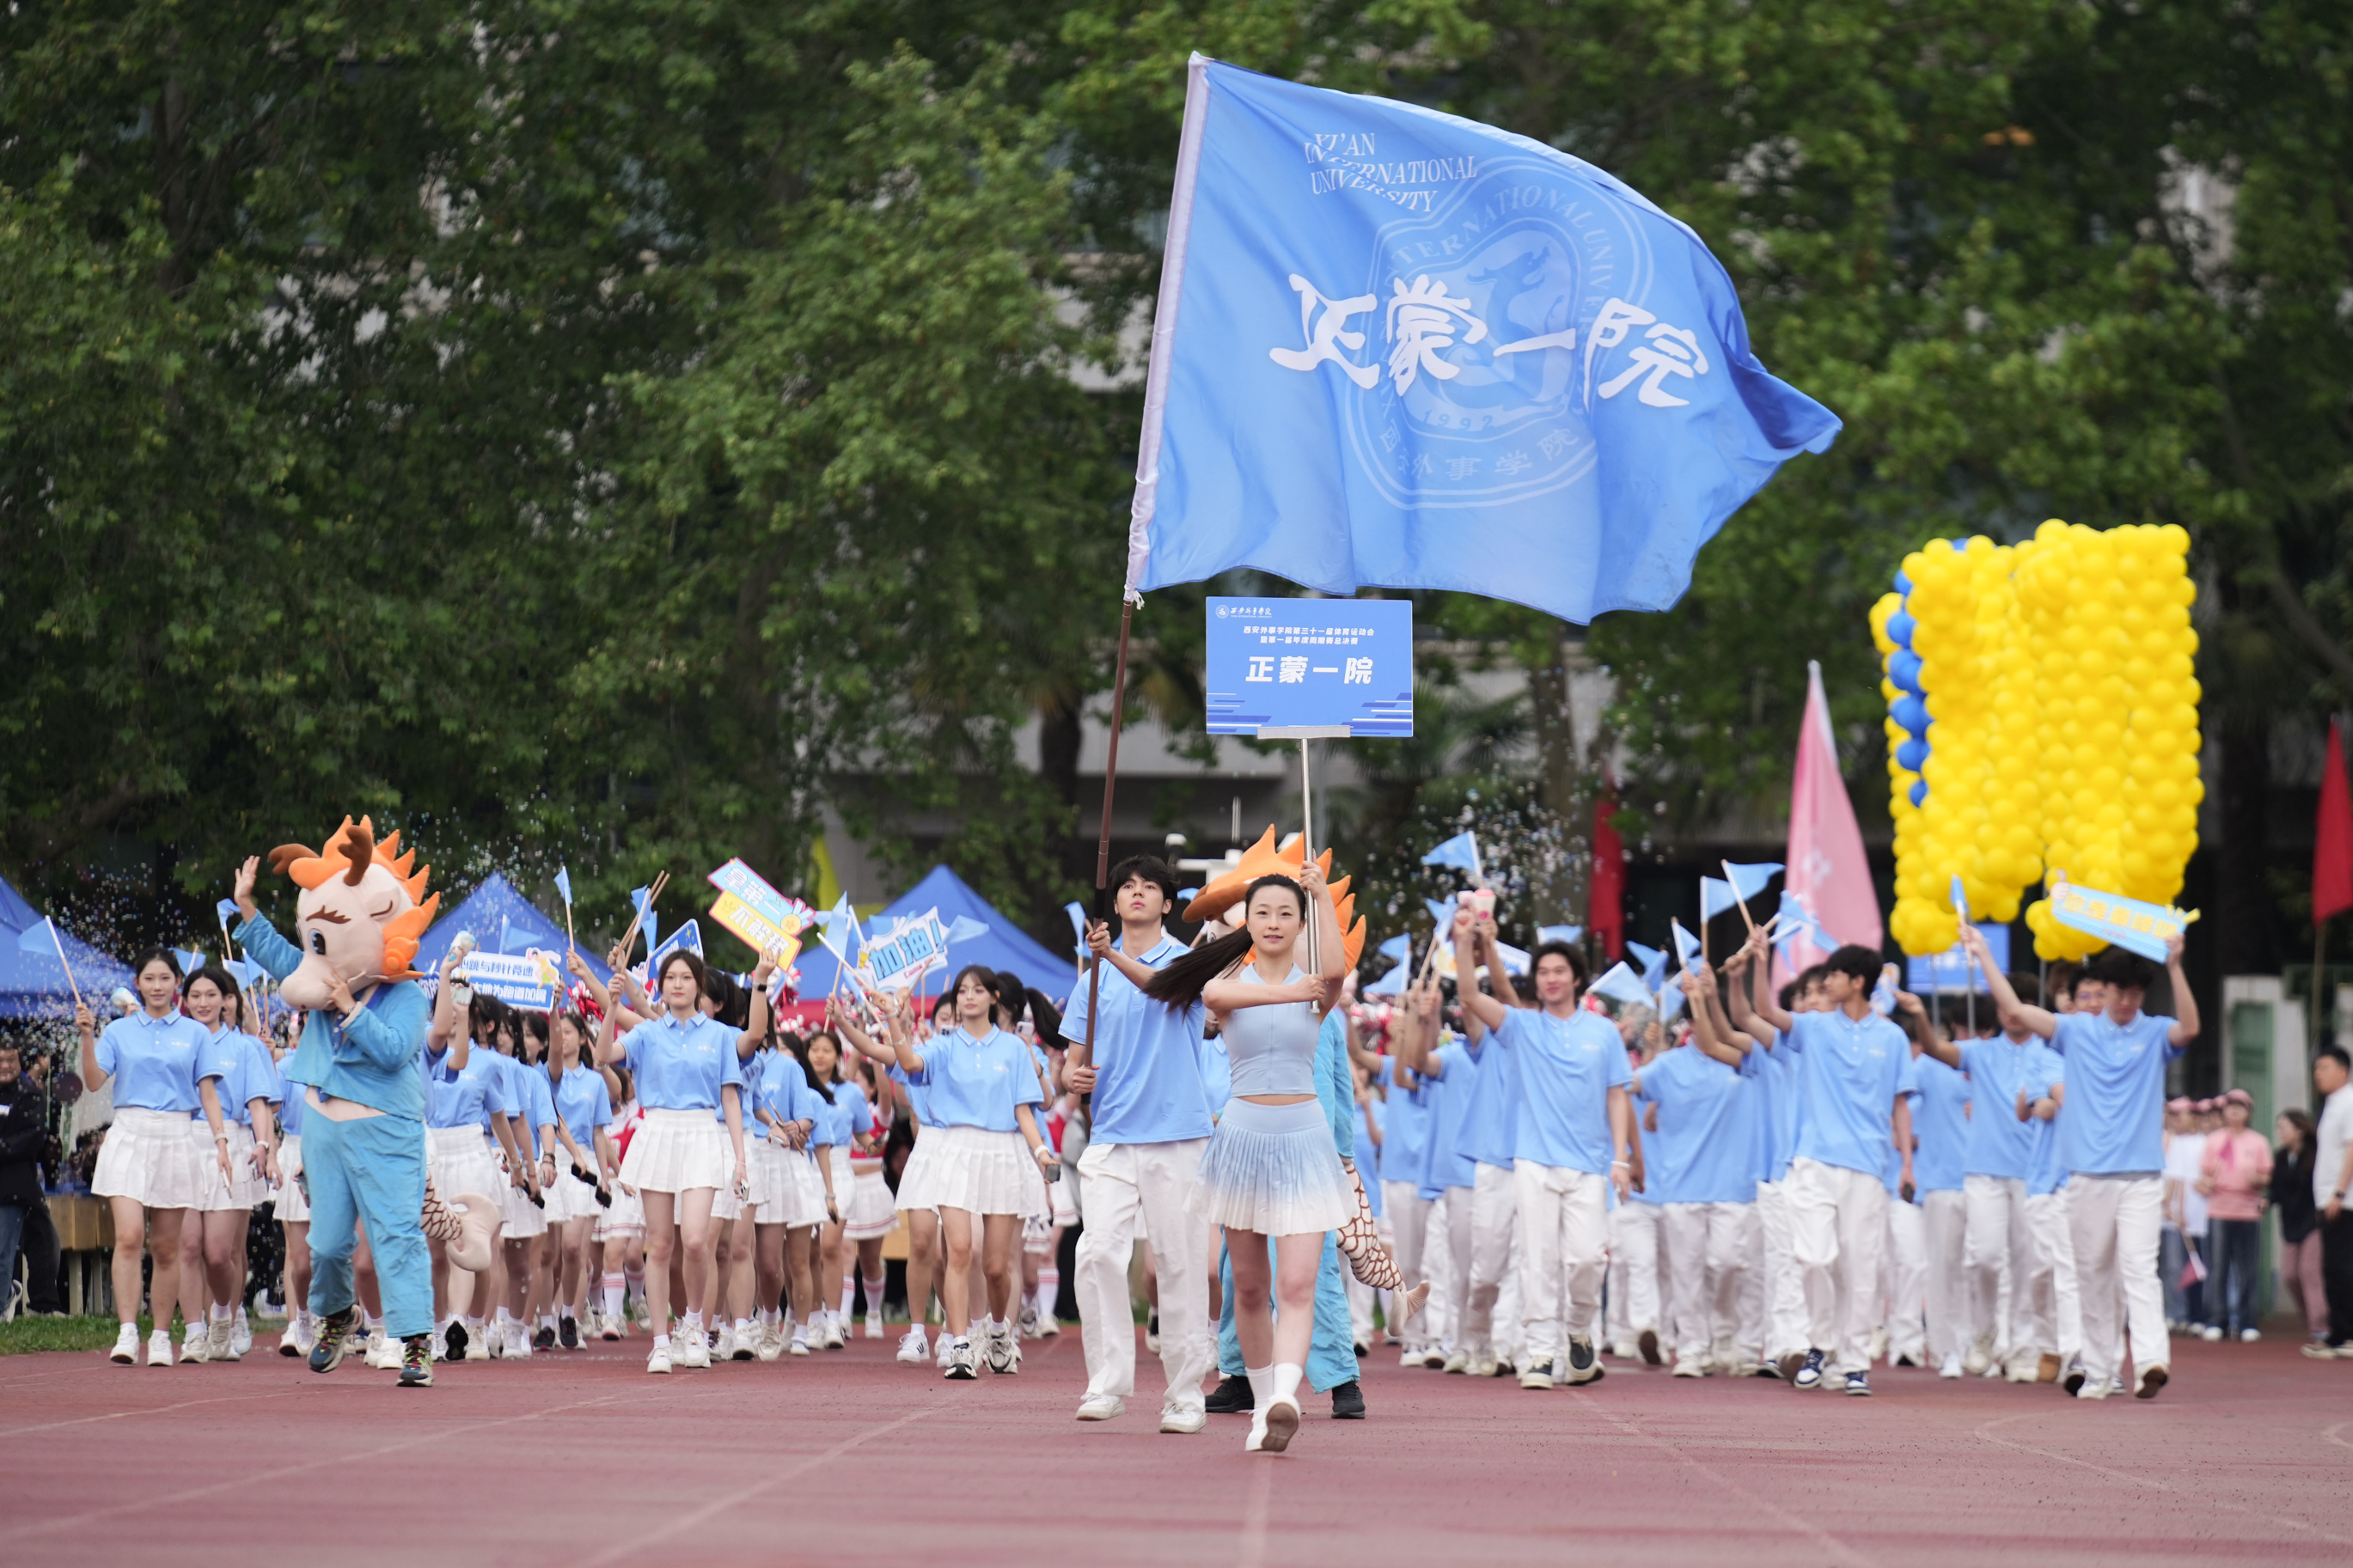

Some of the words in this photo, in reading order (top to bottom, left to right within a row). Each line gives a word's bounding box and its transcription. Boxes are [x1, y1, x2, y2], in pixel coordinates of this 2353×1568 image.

[1311, 168, 1438, 212] UNIVERSITY
[1269, 273, 1708, 412] 正蒙一院
[1422, 409, 1495, 430] 1992
[1245, 656, 1374, 685] 正蒙一院
[723, 867, 781, 916] 拿第一
[729, 903, 791, 956] 不解释
